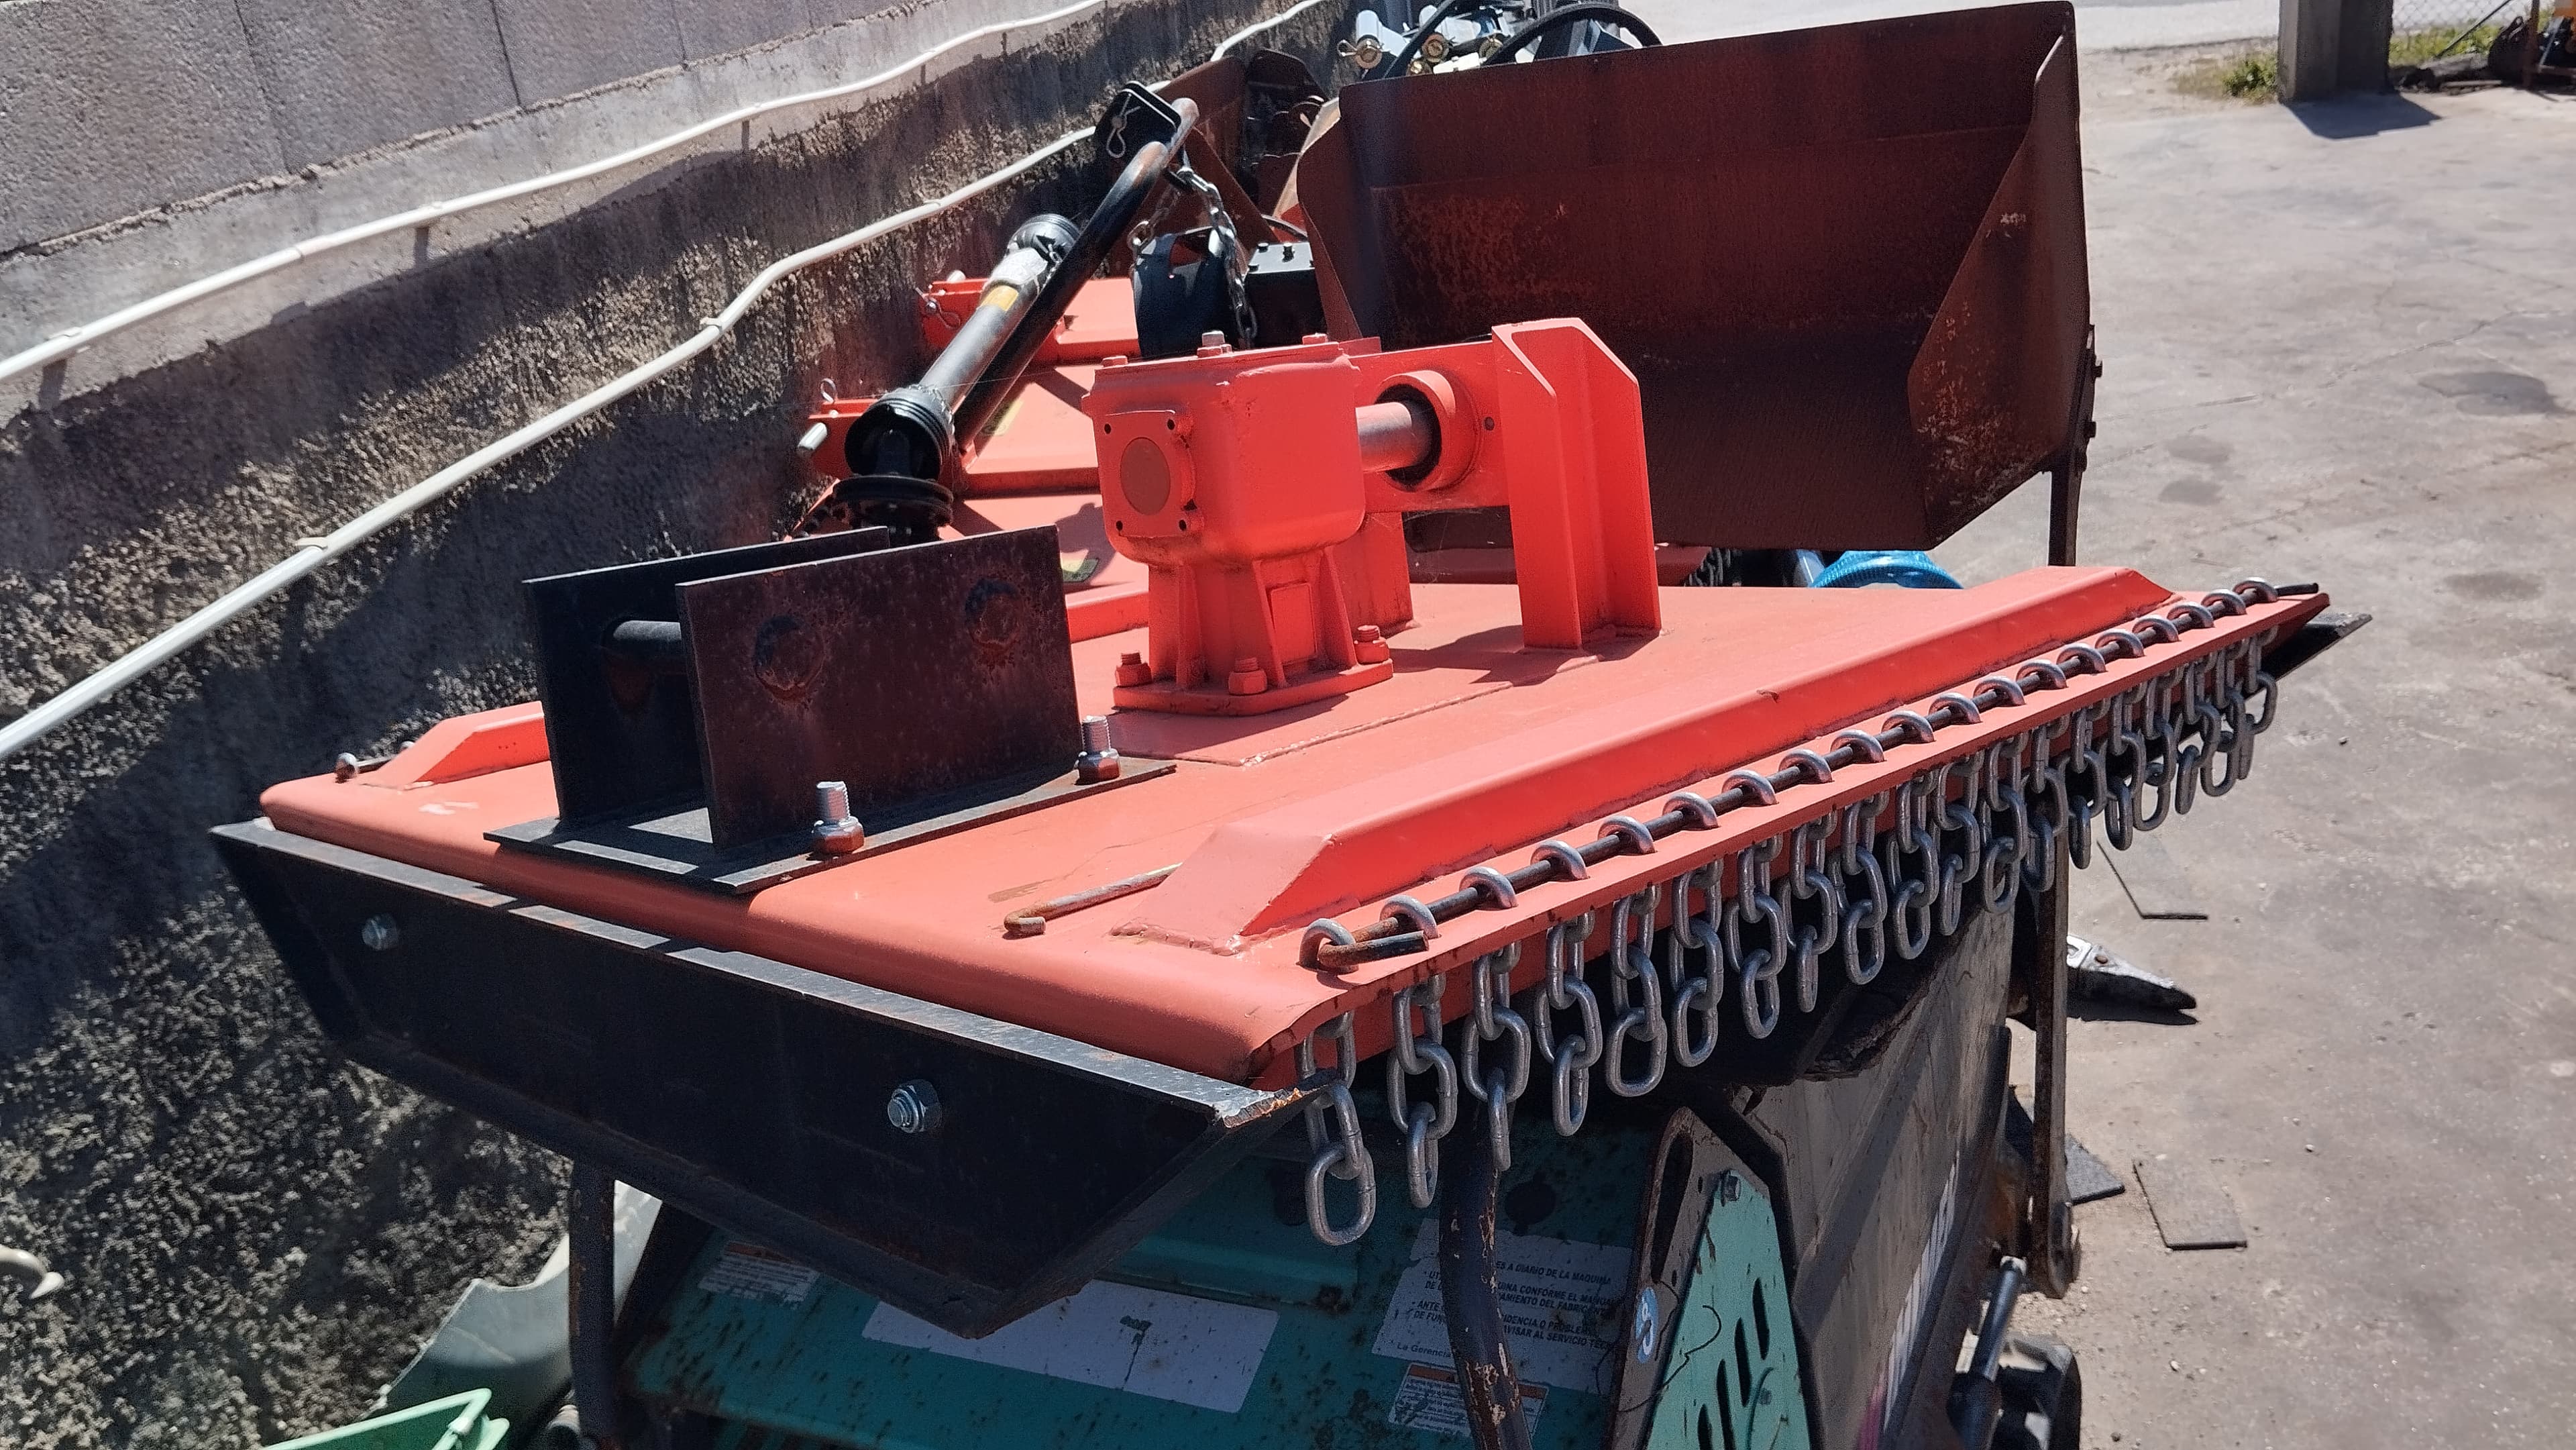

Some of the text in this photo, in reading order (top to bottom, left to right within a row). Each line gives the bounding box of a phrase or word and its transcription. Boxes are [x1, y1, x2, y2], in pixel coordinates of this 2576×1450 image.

[1546, 1267, 1557, 1278] DE
[1559, 1270, 1570, 1279] LA
[1425, 1280, 1436, 1290] DE
[1519, 1285, 1566, 1300] CONFORME
[1568, 1292, 1577, 1302] EL
[1539, 1298, 1554, 1309] DEL
[1413, 1310, 1426, 1319] DE
[1534, 1330, 1544, 1339] AL
